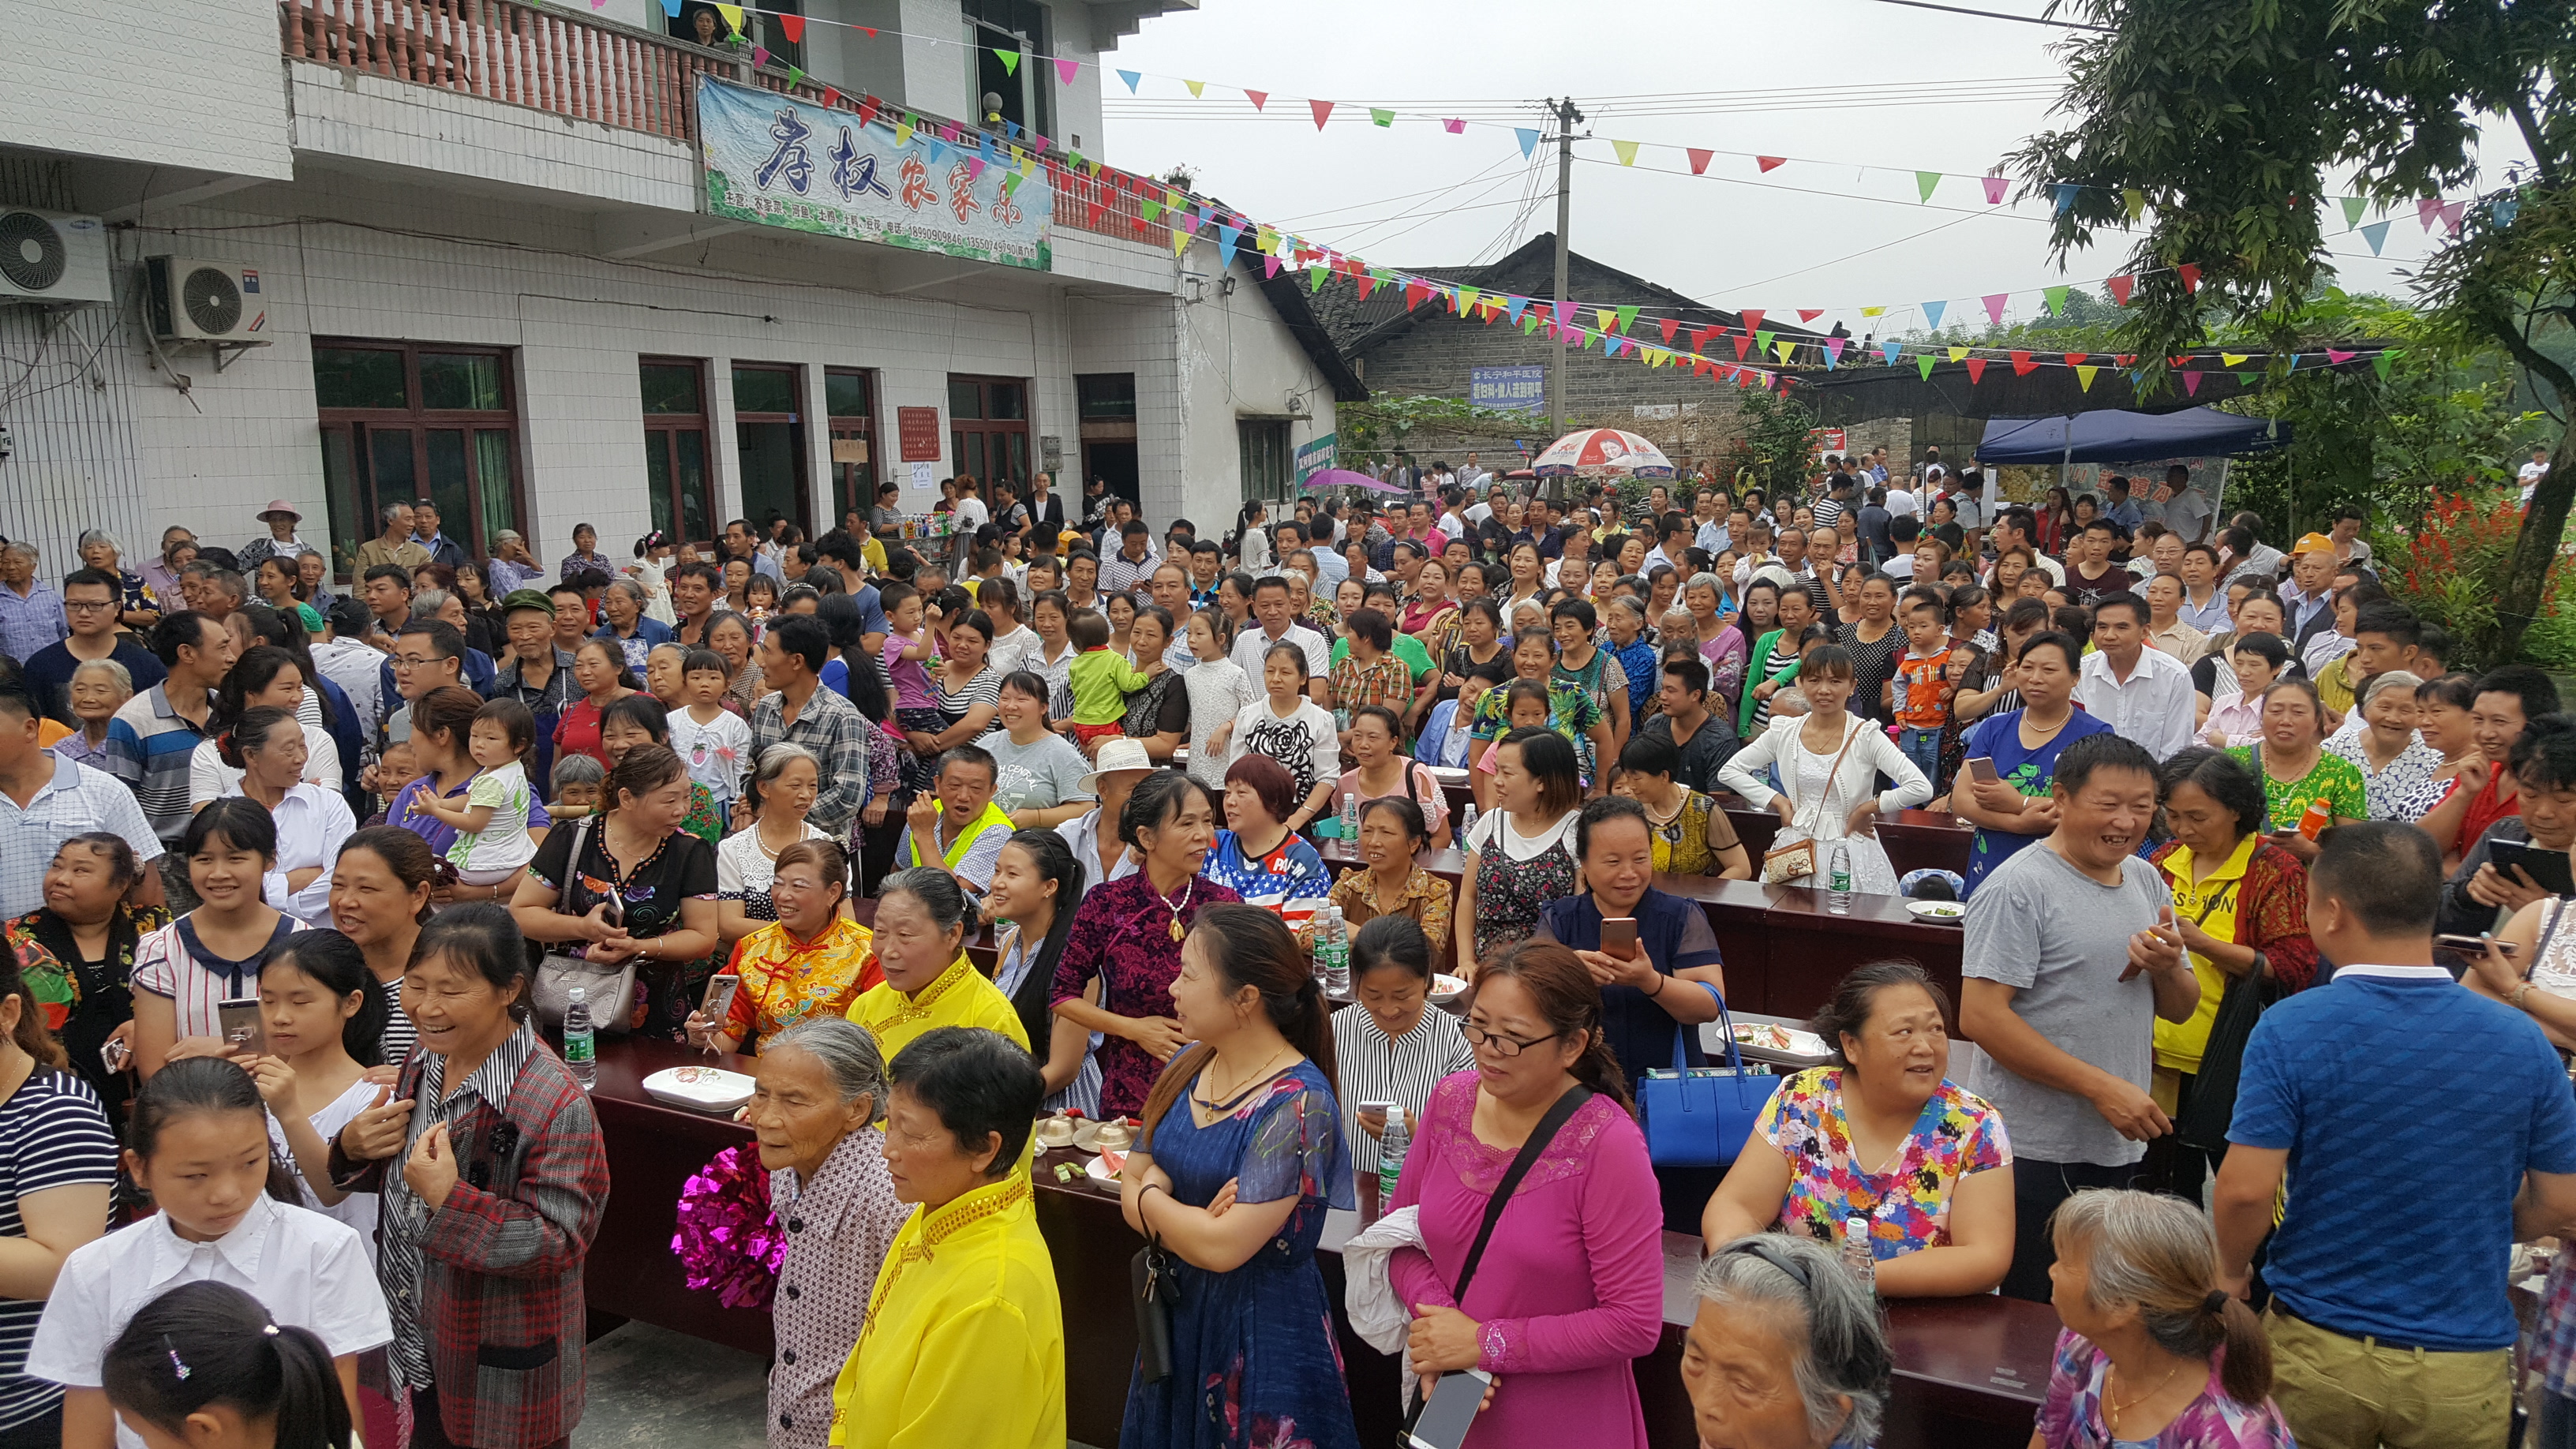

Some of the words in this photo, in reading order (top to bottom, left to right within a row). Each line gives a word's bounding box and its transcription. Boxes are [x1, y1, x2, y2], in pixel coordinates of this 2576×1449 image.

[1482, 369, 1542, 380] 长宁和平医院
[1008, 764, 1038, 792] CENTRAL
